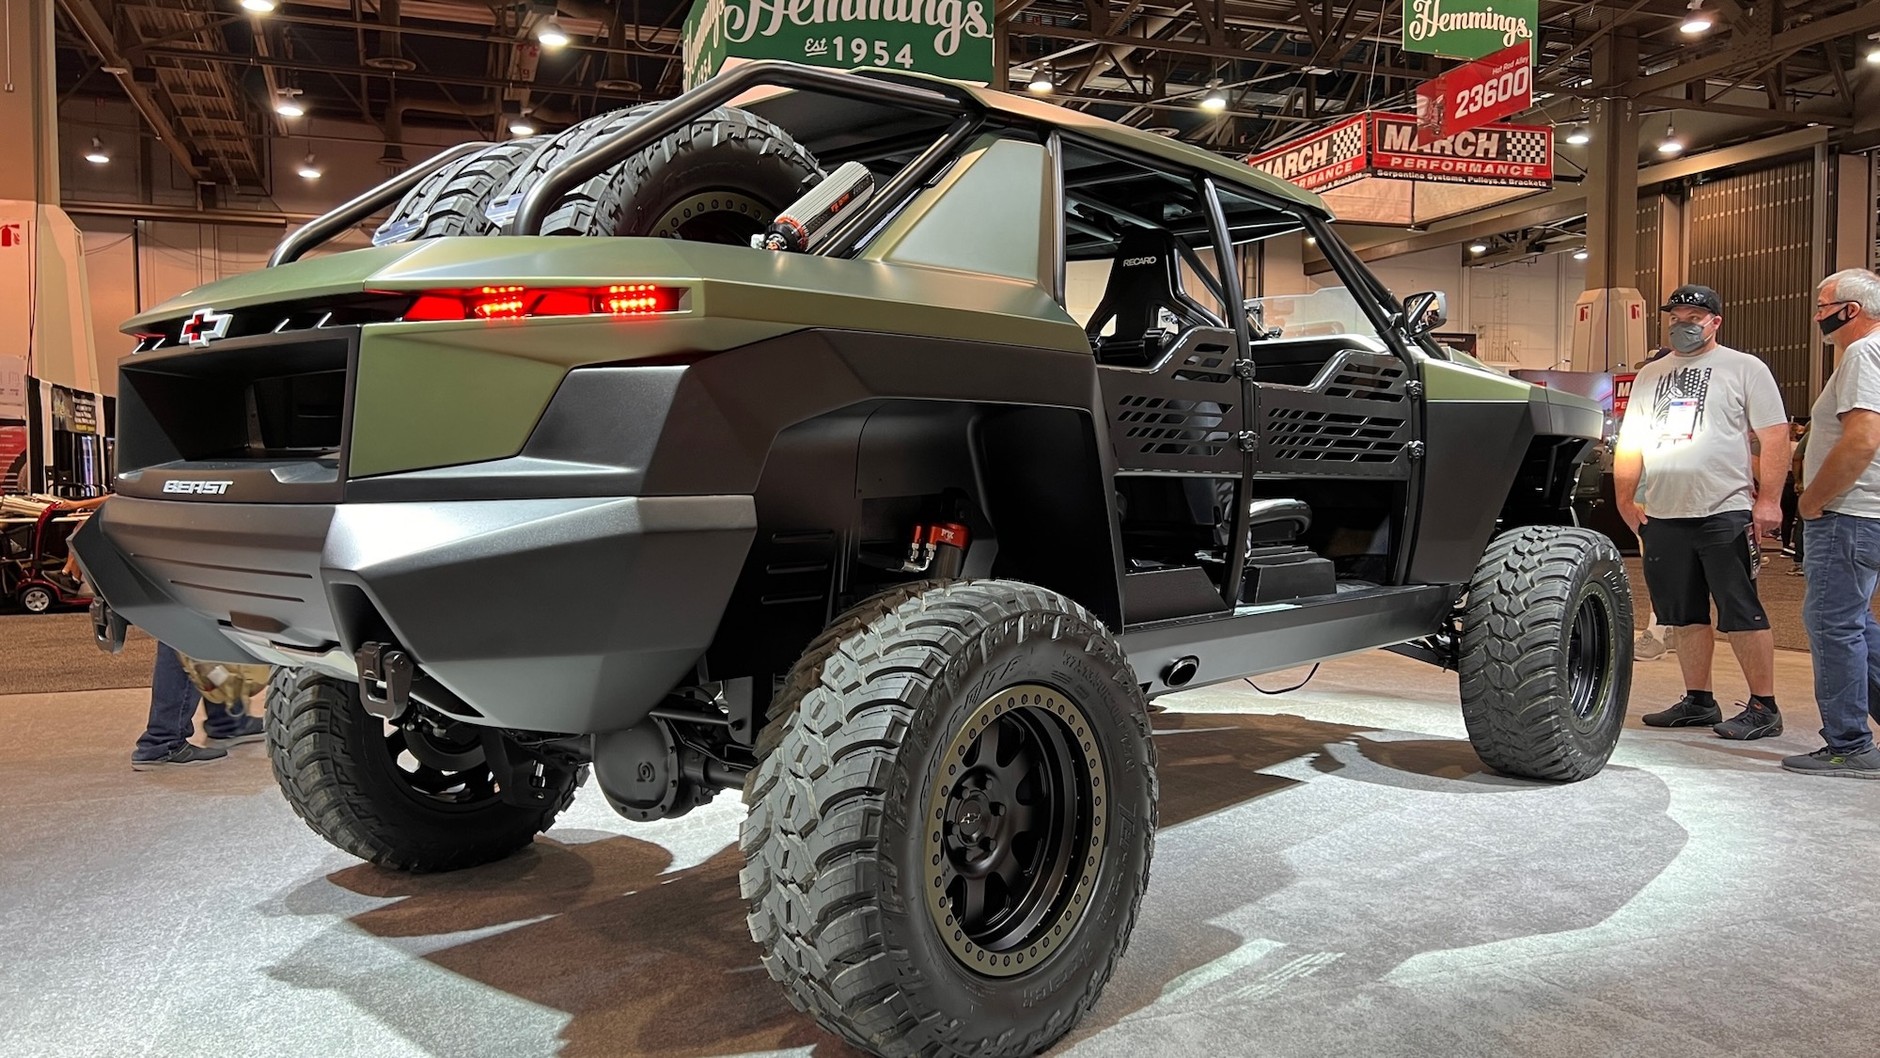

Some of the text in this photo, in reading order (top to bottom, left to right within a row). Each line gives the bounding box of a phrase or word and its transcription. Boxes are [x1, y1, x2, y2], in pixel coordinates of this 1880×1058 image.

[1409, 0, 1532, 47] Hemmings
[805, 36, 914, 69] Est 1954
[1492, 55, 1529, 75] Hot Rod Alley
[1454, 66, 1529, 119] 23600
[1383, 124, 1499, 158] MRCH
[1390, 157, 1534, 176] PERFORMANCE
[1376, 169, 1425, 180] Serpentine
[1509, 178, 1547, 186] Brackets
[1123, 256, 1157, 267] RECARO
[163, 480, 233, 495] BEAST
